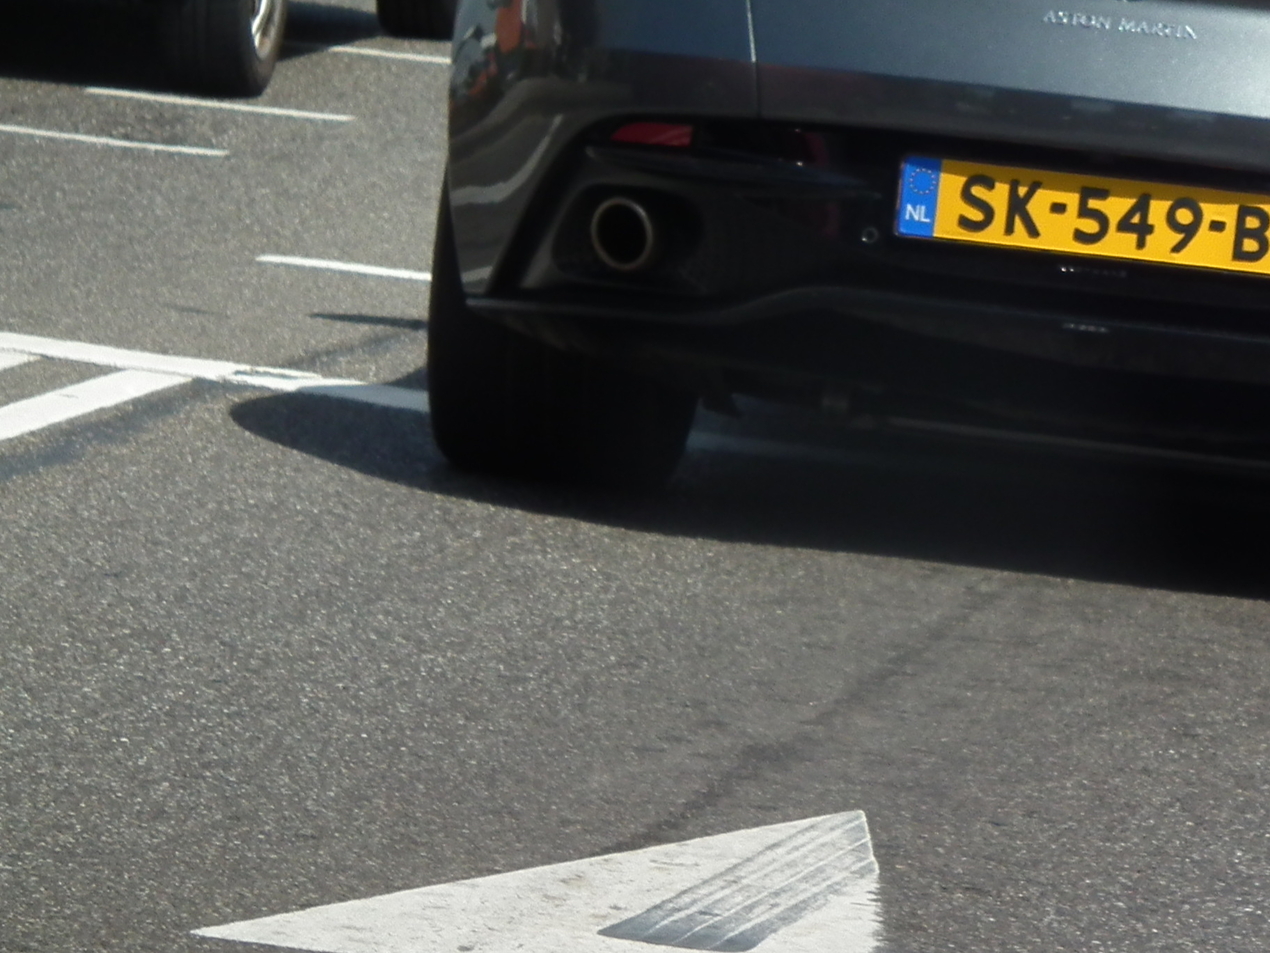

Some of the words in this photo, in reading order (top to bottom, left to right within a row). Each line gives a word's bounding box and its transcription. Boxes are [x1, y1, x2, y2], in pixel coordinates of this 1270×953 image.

[1043, 10, 1112, 30] ASTON
[1118, 17, 1198, 40] MARTIN
[905, 204, 931, 224] NL
